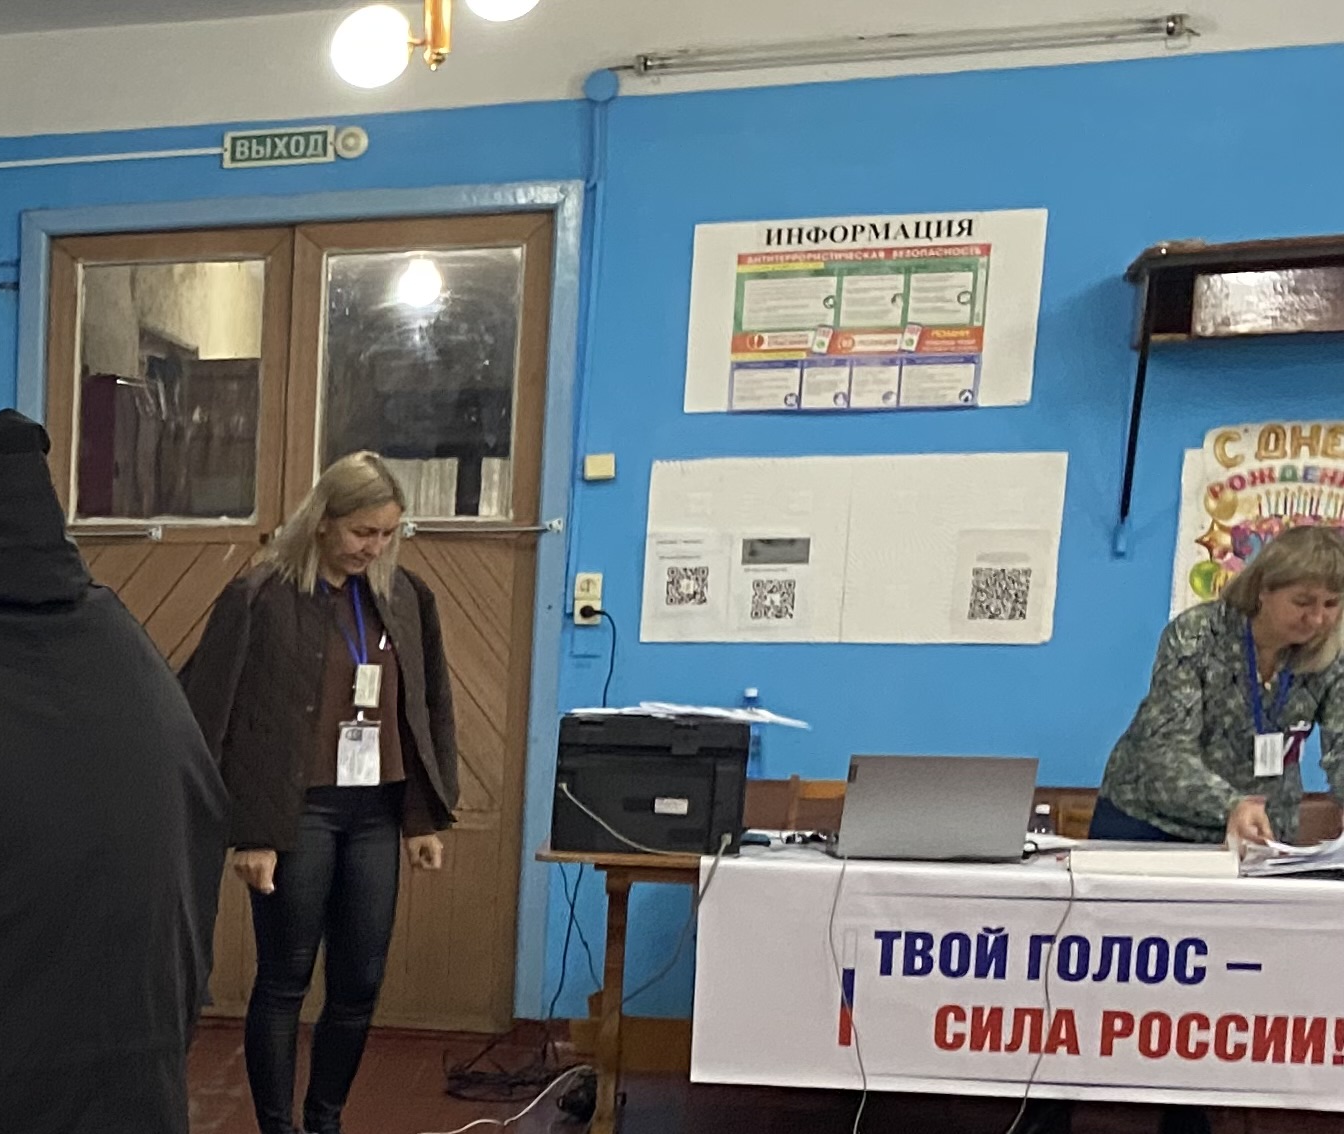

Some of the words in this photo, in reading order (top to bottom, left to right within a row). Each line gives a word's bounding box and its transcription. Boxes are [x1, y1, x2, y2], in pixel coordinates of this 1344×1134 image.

[235, 135, 325, 159] ВЫХОД
[765, 219, 974, 247] ИНФОРМАЦИЯ
[892, 246, 982, 260] БЕЗОПАСНОСТЬ
[1213, 430, 1245, 468] С
[874, 926, 1010, 981] ТВОЙ
[1027, 934, 1209, 987] ГОЛОС
[934, 1003, 1080, 1057] СИЛА
[1099, 1008, 1344, 1067] РОССИИ!
